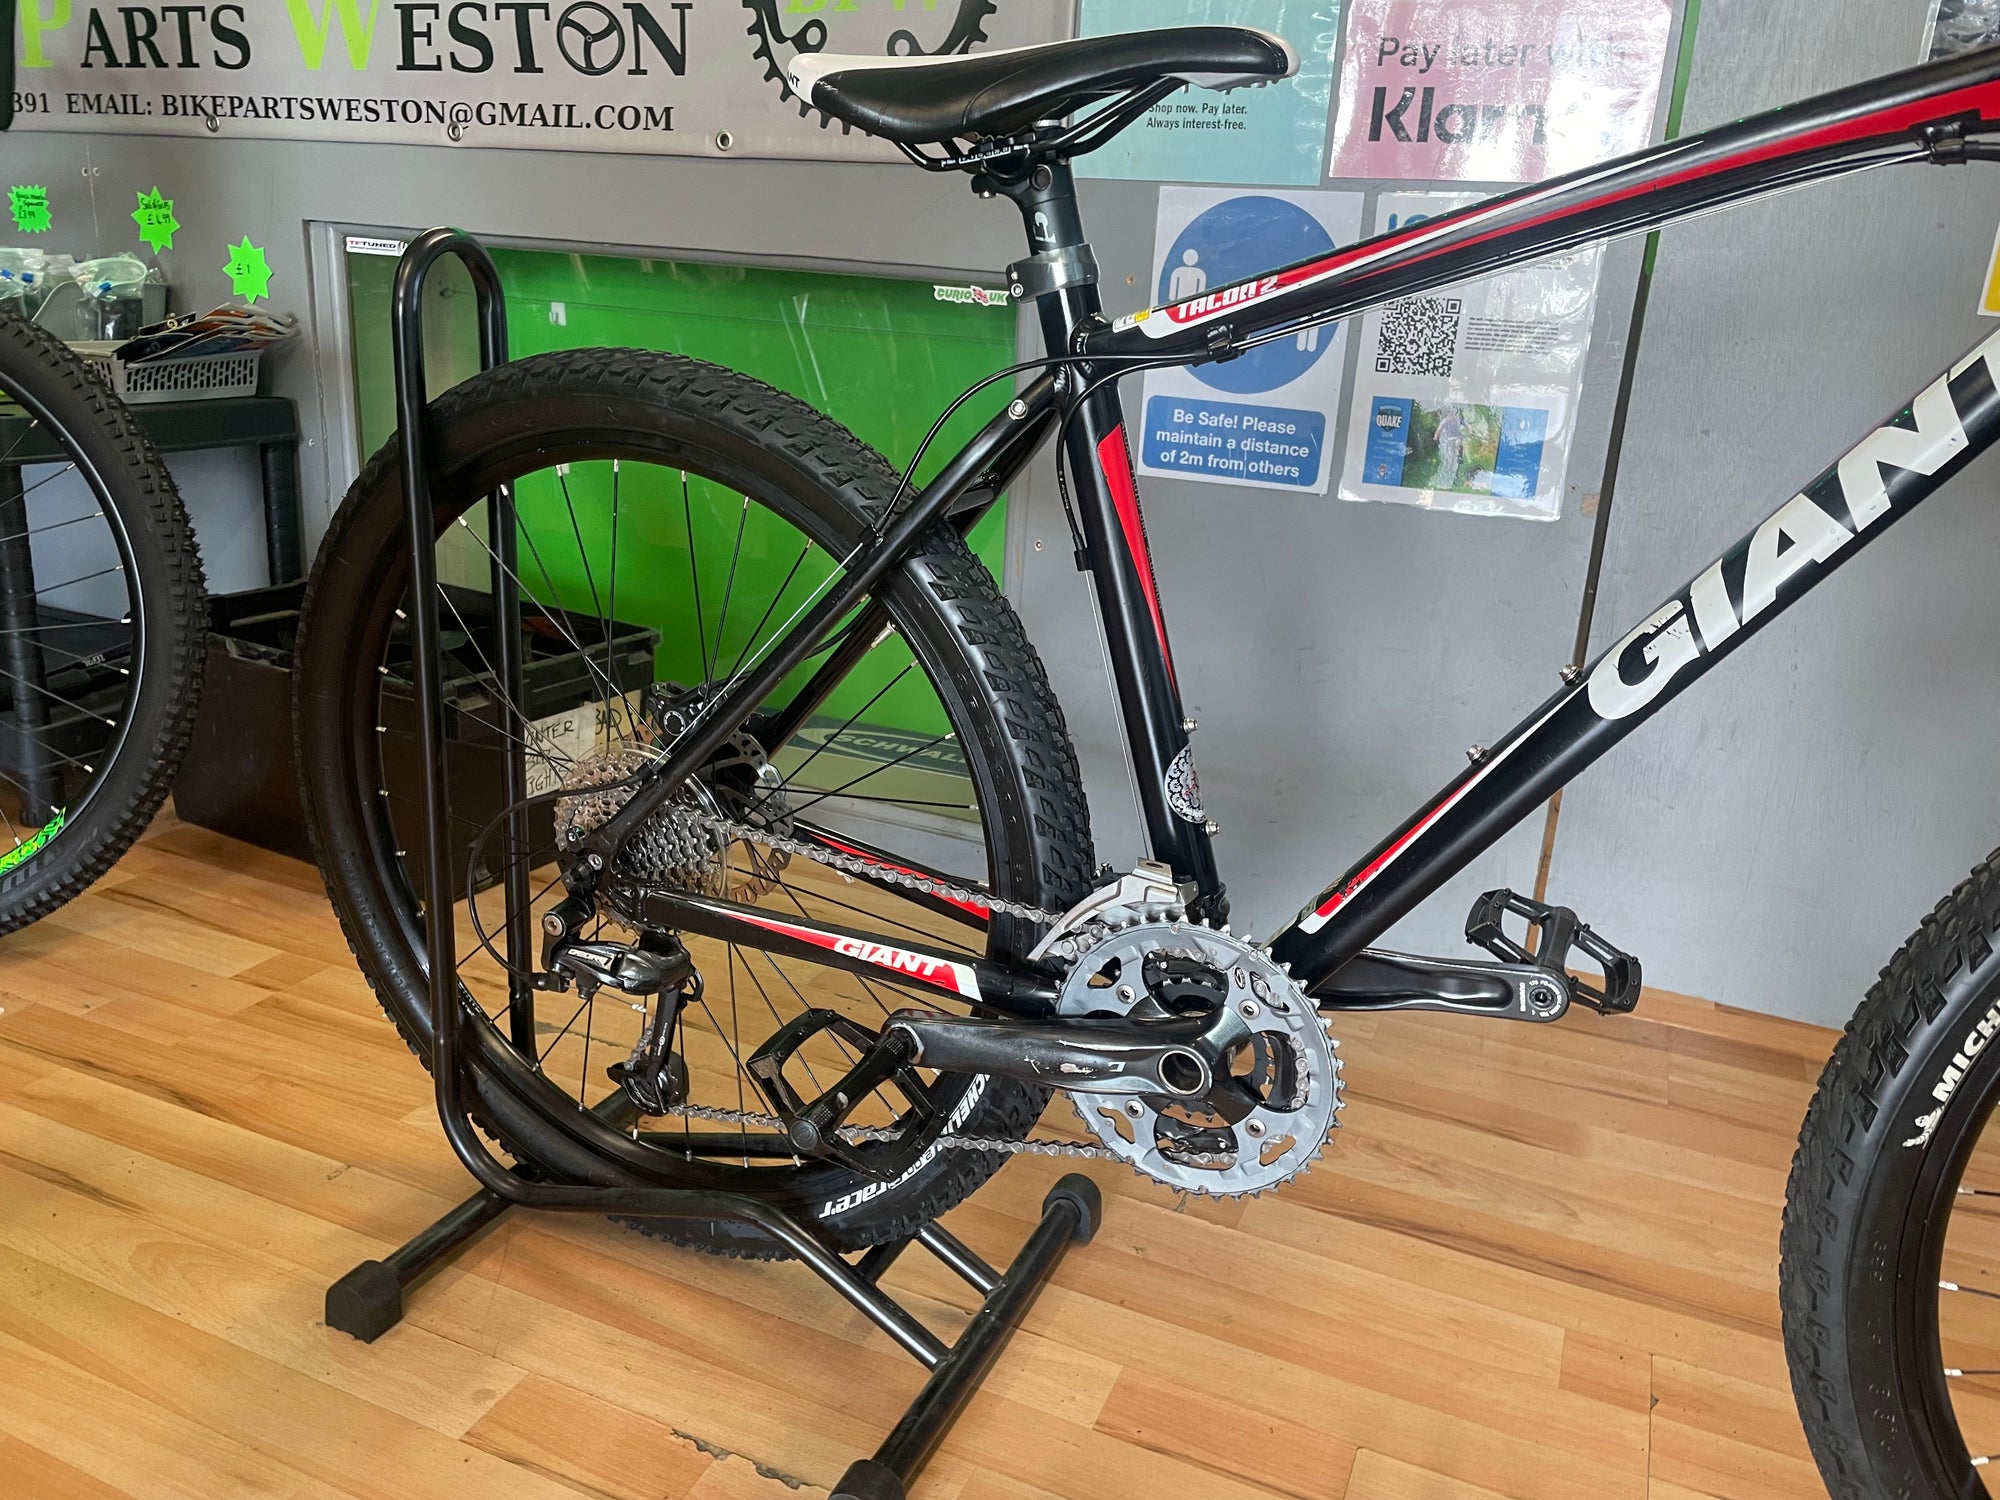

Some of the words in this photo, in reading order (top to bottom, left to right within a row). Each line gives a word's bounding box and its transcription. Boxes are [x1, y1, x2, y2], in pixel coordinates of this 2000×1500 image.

[19, 0, 251, 69] PARTS
[284, 0, 693, 75] WESTON
[1377, 37, 1440, 73] Pay
[66, 94, 152, 115] EMAIL:
[161, 94, 674, 131] BIKEPARTSWESTON@GMAIL.COM
[1147, 117, 1180, 130] Always
[1183, 118, 1247, 130] interest-free.
[1148, 103, 1173, 115] Shop
[1176, 104, 1198, 114] now.
[1202, 103, 1221, 116] Pay
[1222, 103, 1248, 115] later.
[937, 288, 973, 301] CURIO
[989, 292, 1007, 303] UK
[1177, 281, 1258, 320] TALON
[1260, 275, 1279, 295] 2
[1173, 409, 1194, 424] Be
[1198, 411, 1238, 429] Safe!
[1242, 416, 1296, 436] Please
[1376, 414, 1403, 428] QUAKE
[1156, 430, 1222, 448] maintain
[1226, 438, 1236, 449] a
[1240, 438, 1310, 458] distance
[1160, 450, 1176, 463] of
[1179, 451, 1203, 466] 2m
[1207, 455, 1244, 471] from
[1248, 459, 1300, 478] others
[834, 733, 966, 763] SCHWAL
[834, 936, 946, 977] GIANT
[1932, 999, 2000, 1102] MICH
